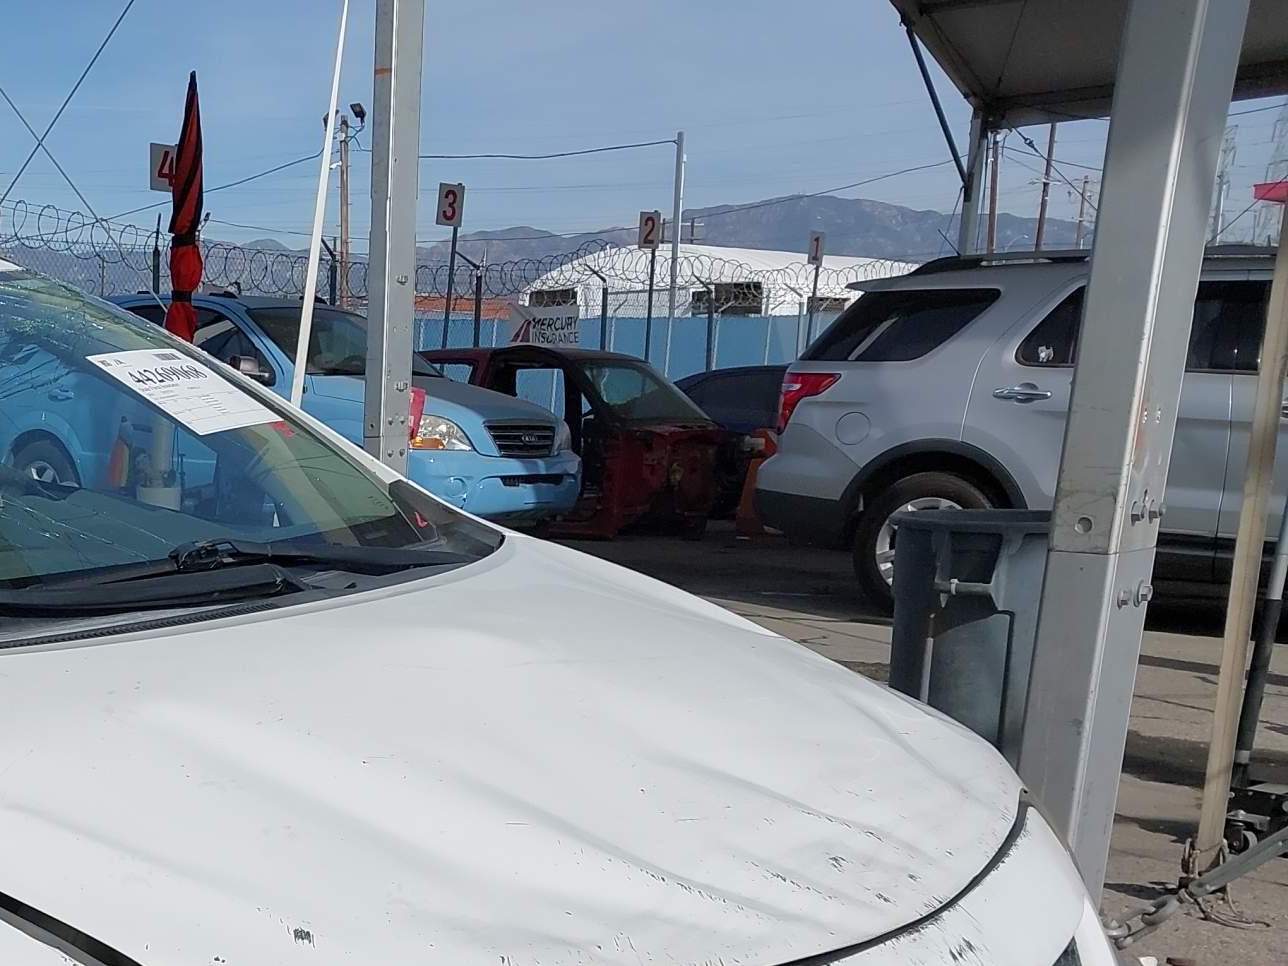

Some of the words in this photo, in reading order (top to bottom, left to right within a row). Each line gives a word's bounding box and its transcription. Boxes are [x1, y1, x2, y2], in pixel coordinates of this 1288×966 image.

[157, 150, 175, 187] 4
[442, 189, 458, 221] 3
[643, 216, 655, 245] 2
[812, 236, 820, 260] 1
[532, 315, 578, 332] MERCURY
[127, 364, 208, 386] 44269068
